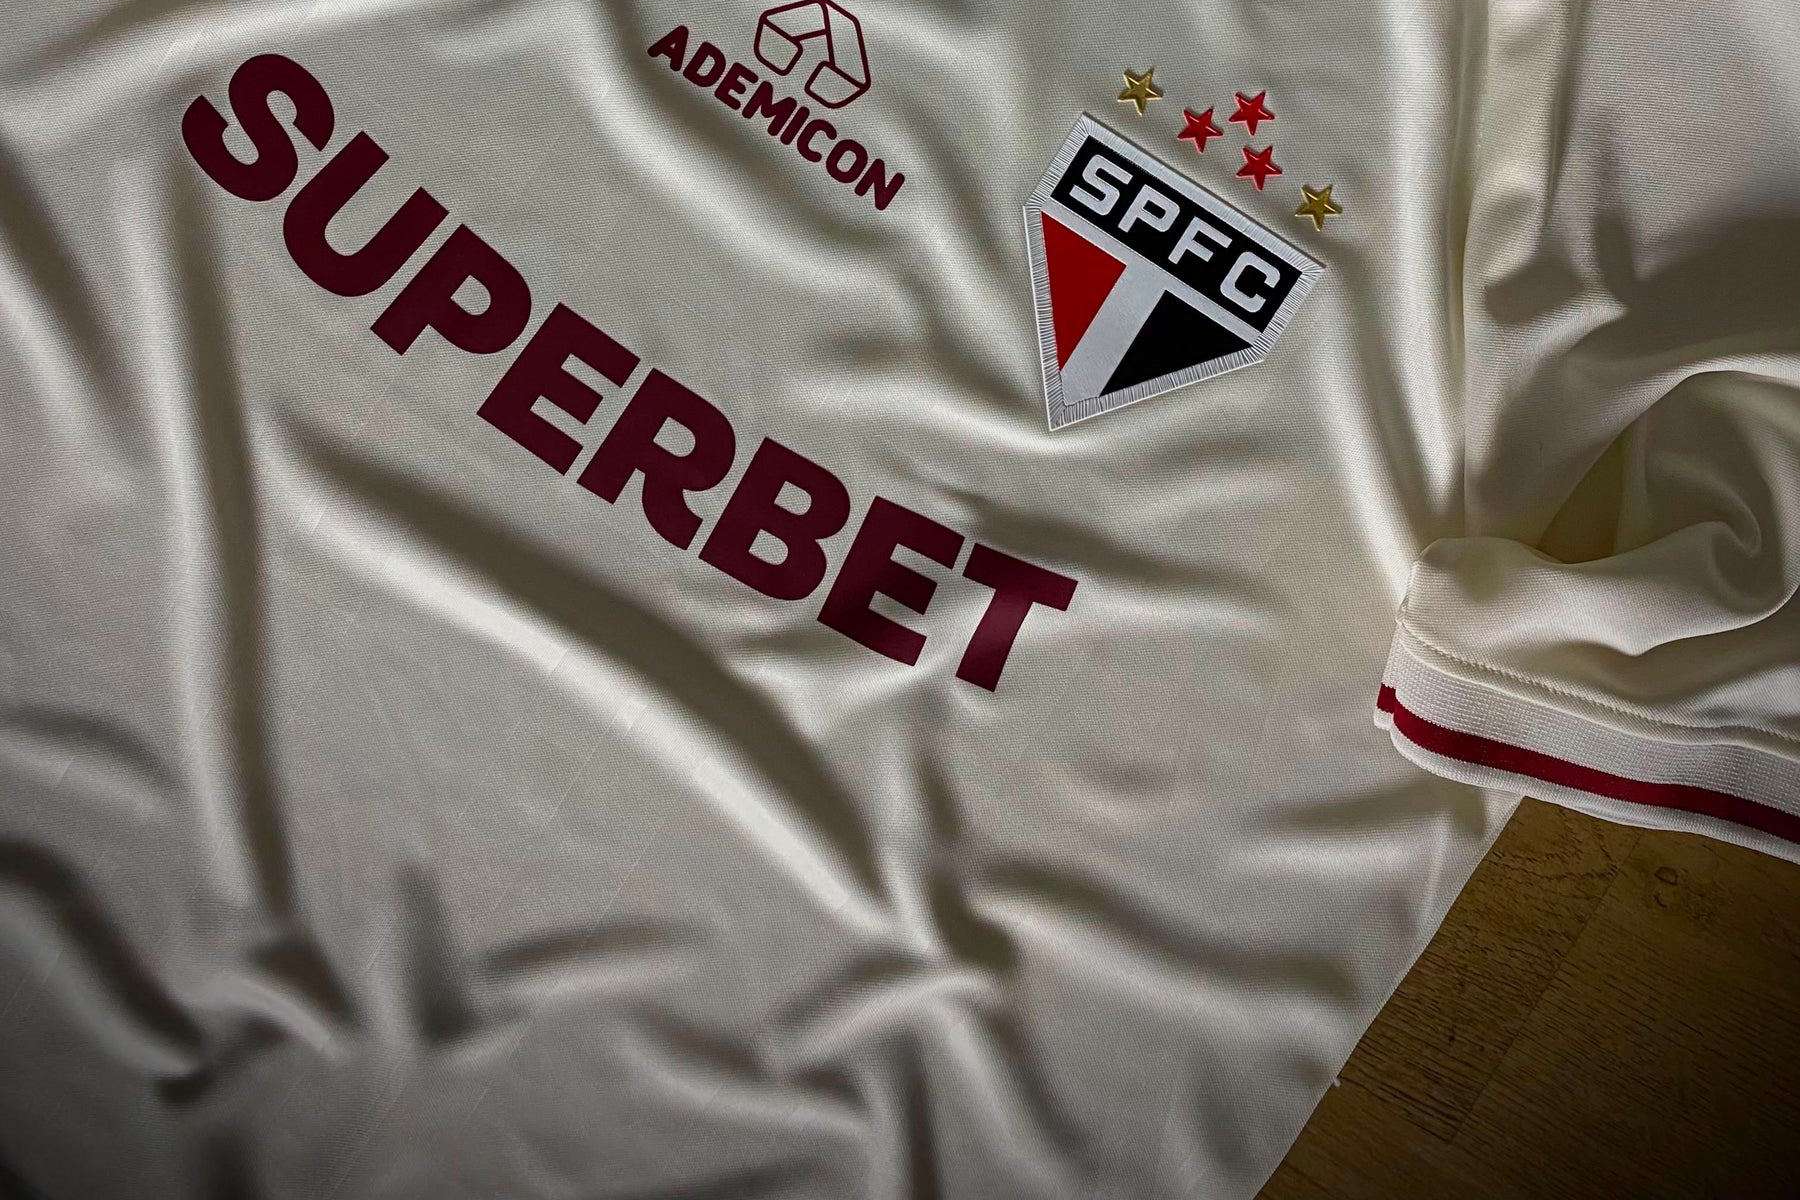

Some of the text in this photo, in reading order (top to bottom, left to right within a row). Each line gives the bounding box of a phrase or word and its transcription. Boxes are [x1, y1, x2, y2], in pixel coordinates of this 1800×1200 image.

[647, 25, 906, 211] ADEMICON
[1068, 154, 1281, 313] SPFC
[181, 53, 1079, 693] SUPERBET
